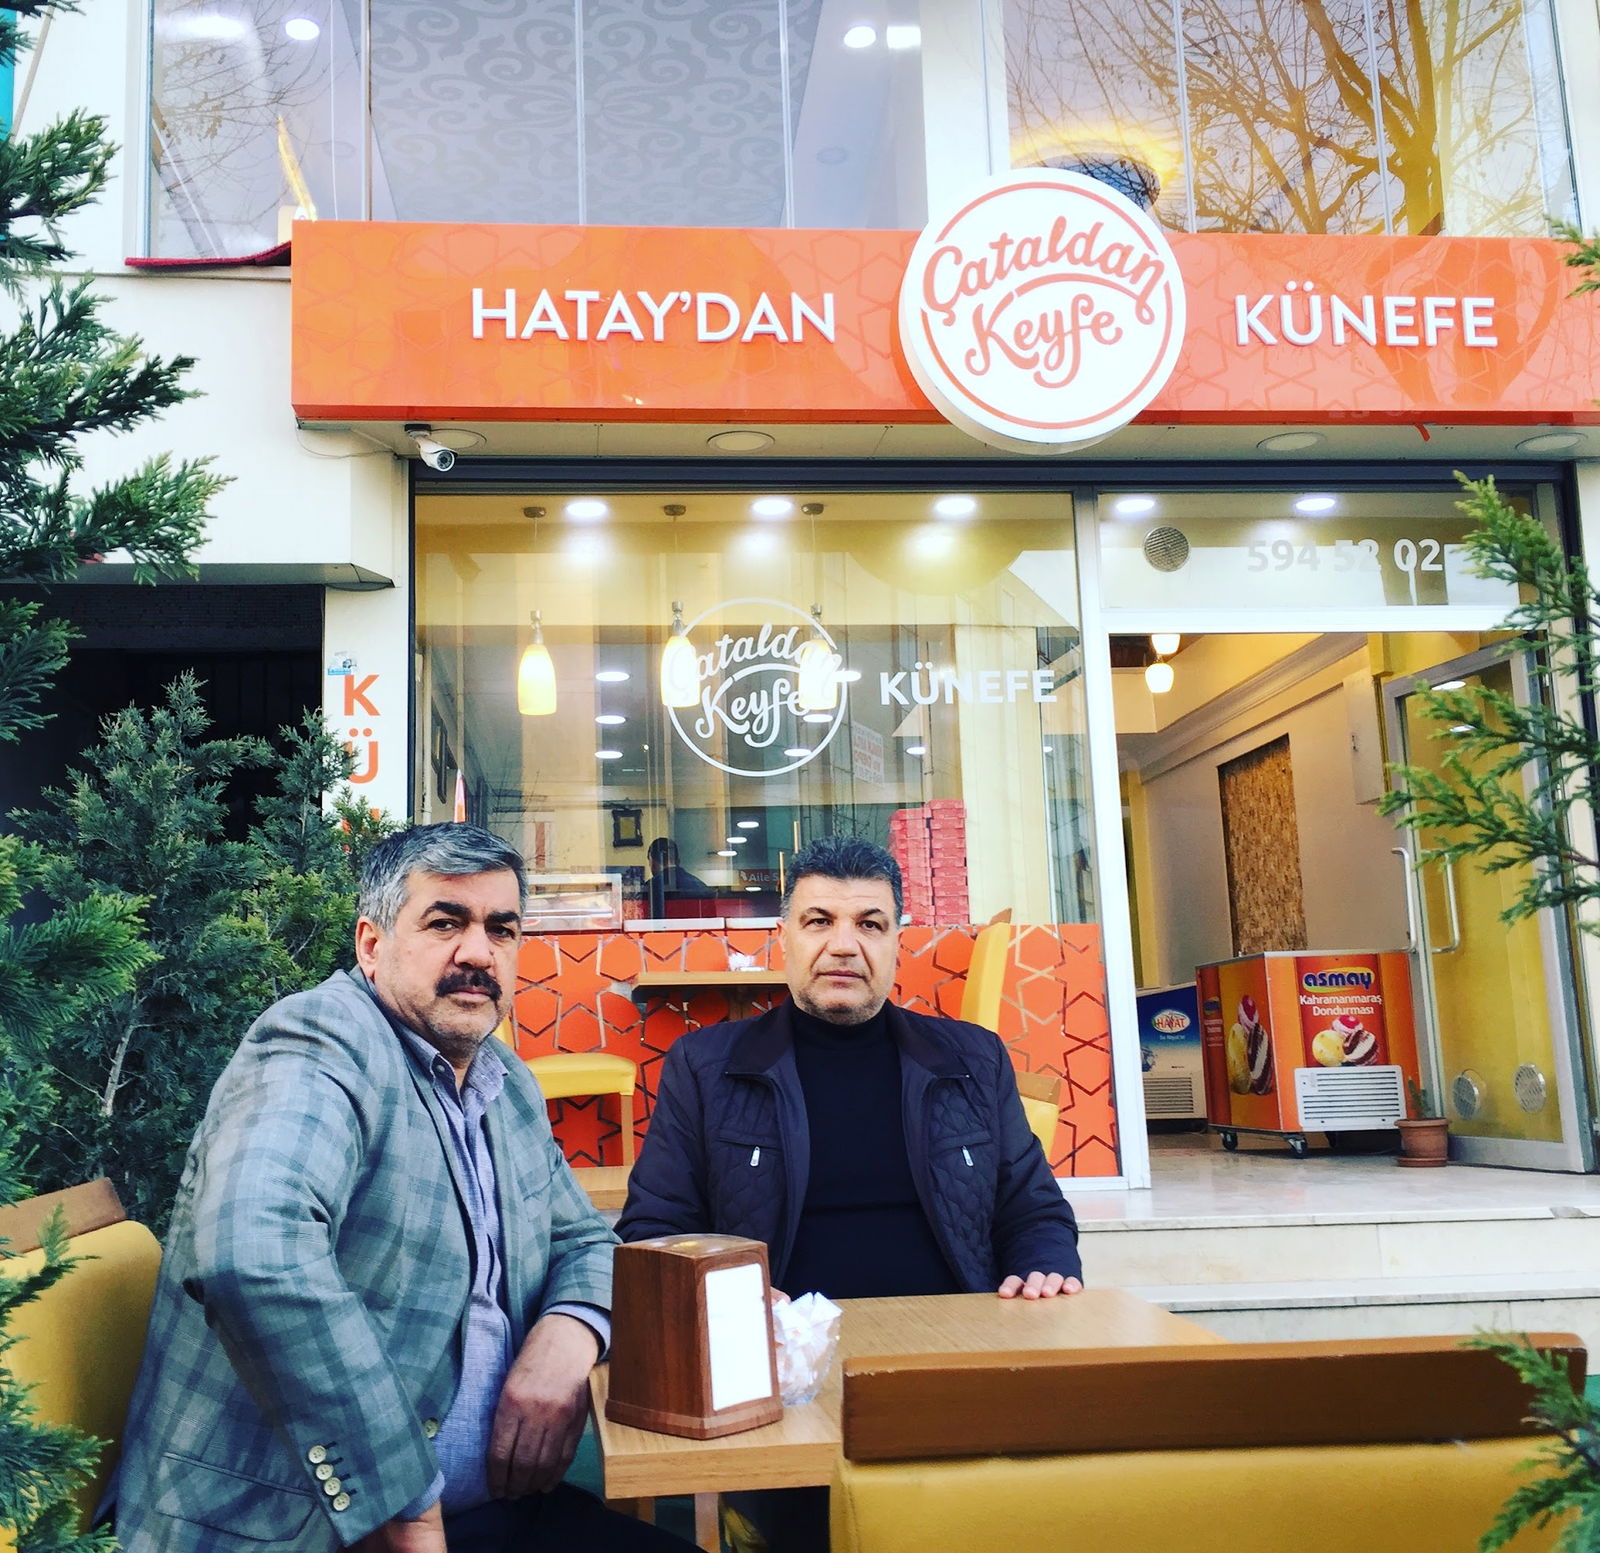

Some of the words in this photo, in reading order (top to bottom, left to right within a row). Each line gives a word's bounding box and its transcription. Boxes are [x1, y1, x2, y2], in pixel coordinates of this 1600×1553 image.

[923, 215, 1167, 327] Çataldan
[1235, 280, 1498, 347] KÜNEFE
[964, 290, 1123, 389] Keyfe
[1247, 539, 1320, 572] 594
[1334, 538, 1381, 572] 52
[1394, 538, 1443, 571] 02
[879, 661, 1057, 706] KÜNEFE
[695, 676, 813, 748] Keyfe
[1299, 995, 1382, 1005] Kahramanmaraş
[1303, 972, 1373, 990] asmay
[1156, 1017, 1185, 1029] HAYAT
[1313, 1005, 1374, 1016] Dondurması
